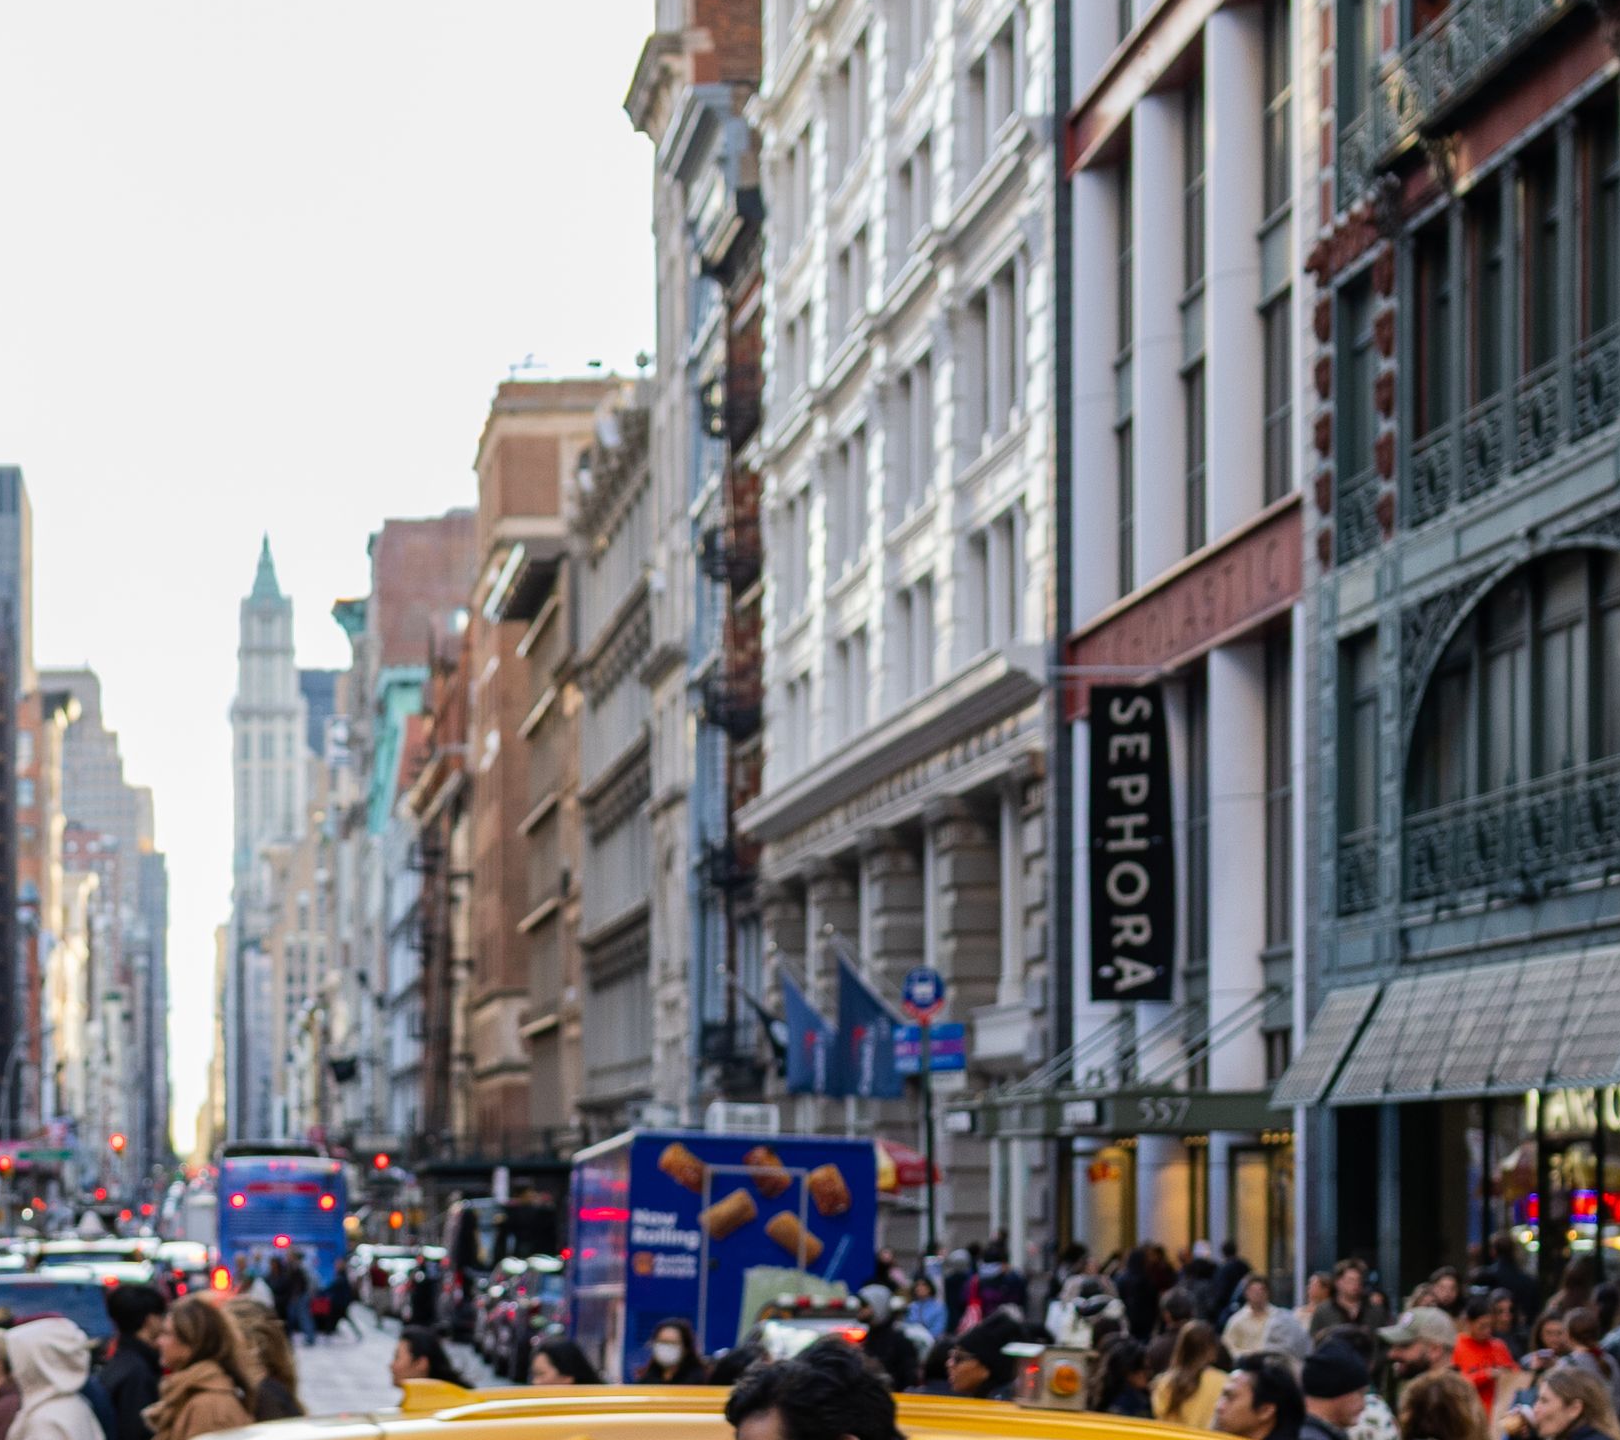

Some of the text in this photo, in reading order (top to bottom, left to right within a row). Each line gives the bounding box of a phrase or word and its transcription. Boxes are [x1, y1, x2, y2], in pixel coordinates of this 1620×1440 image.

[1105, 695, 1156, 992] SEPHORA
[1136, 1096, 1192, 1127] 557
[632, 1226, 700, 1251] Rolling
